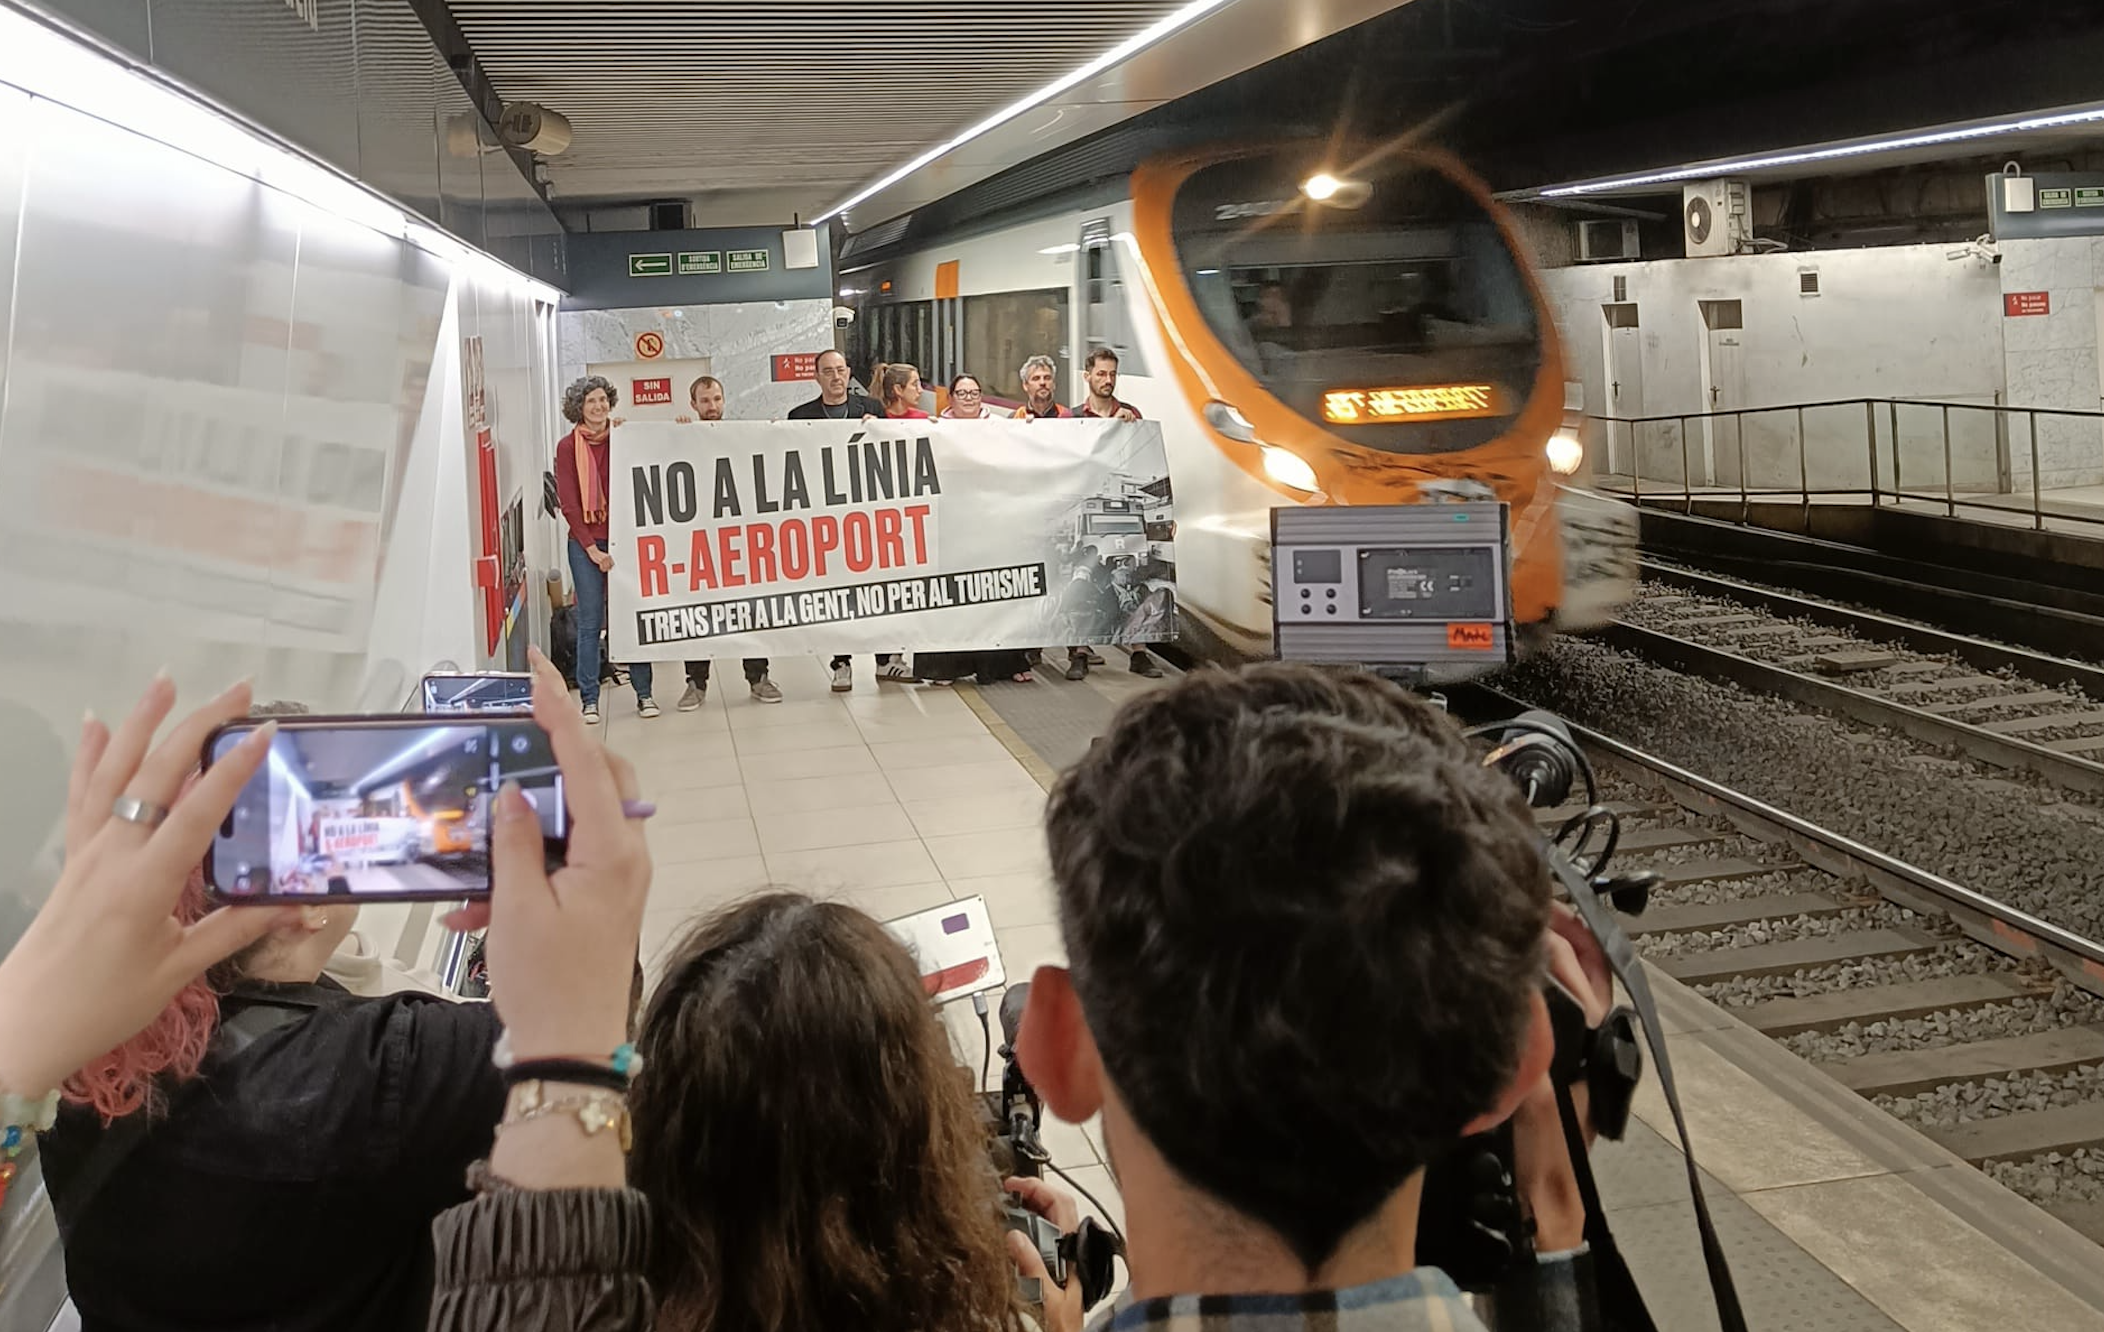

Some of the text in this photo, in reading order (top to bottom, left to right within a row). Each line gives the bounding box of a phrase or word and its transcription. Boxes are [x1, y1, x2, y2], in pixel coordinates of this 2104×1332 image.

[635, 392, 670, 403] SALIDA
[643, 381, 661, 390] SIN
[632, 432, 941, 528] NO A LA LÍNIA
[637, 505, 931, 597] R-AEROPORT
[640, 565, 1042, 643] TRENS PER A LA GENT, NO PER AL TURISME
